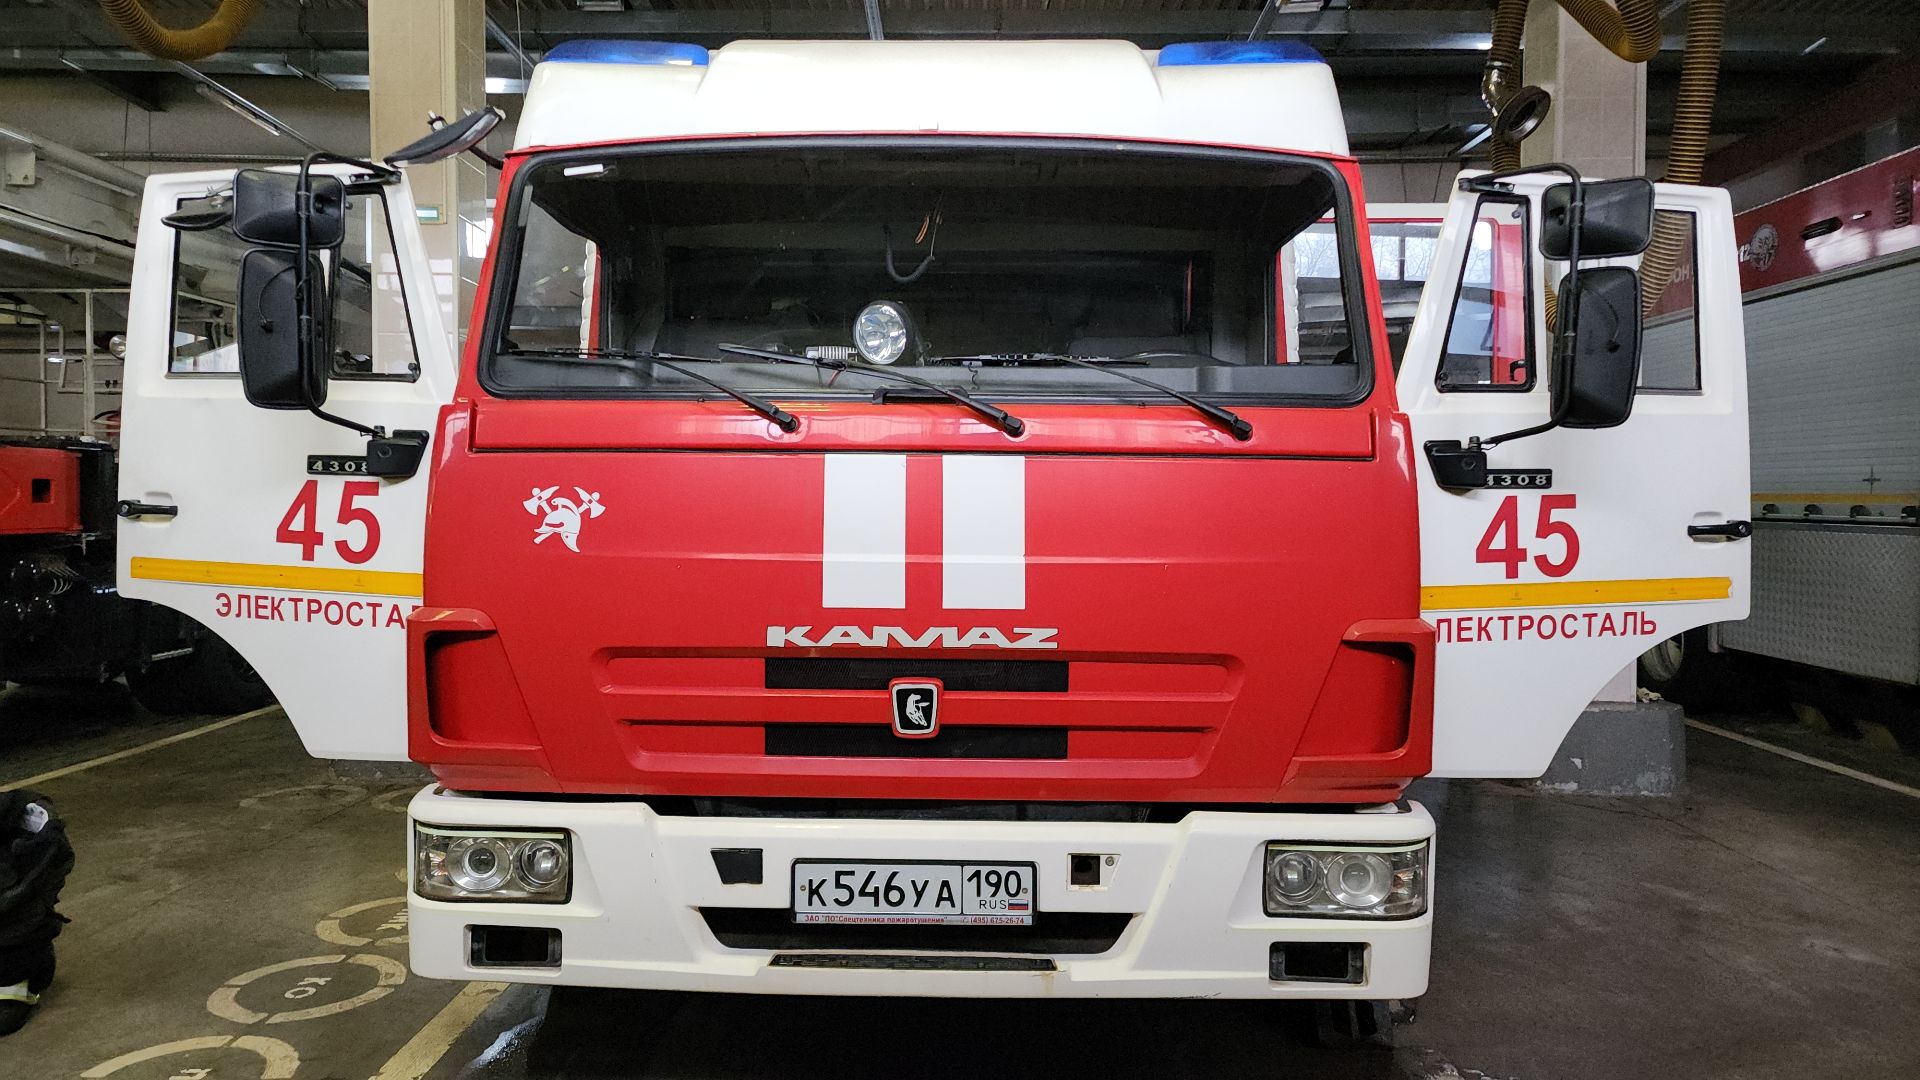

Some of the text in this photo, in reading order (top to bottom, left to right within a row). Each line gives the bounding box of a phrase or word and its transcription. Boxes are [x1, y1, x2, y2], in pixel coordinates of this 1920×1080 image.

[275, 479, 382, 564] 45
[1475, 493, 1580, 579] 45
[215, 592, 424, 630] ЭЛЕКТРОСТА
[1435, 611, 1658, 643] ЛЕКТРОСТАЛЬ
[766, 625, 1059, 649] KAMAZ
[807, 870, 956, 908] К546УА
[966, 869, 1022, 898] 190
[979, 900, 1007, 910] RUS
